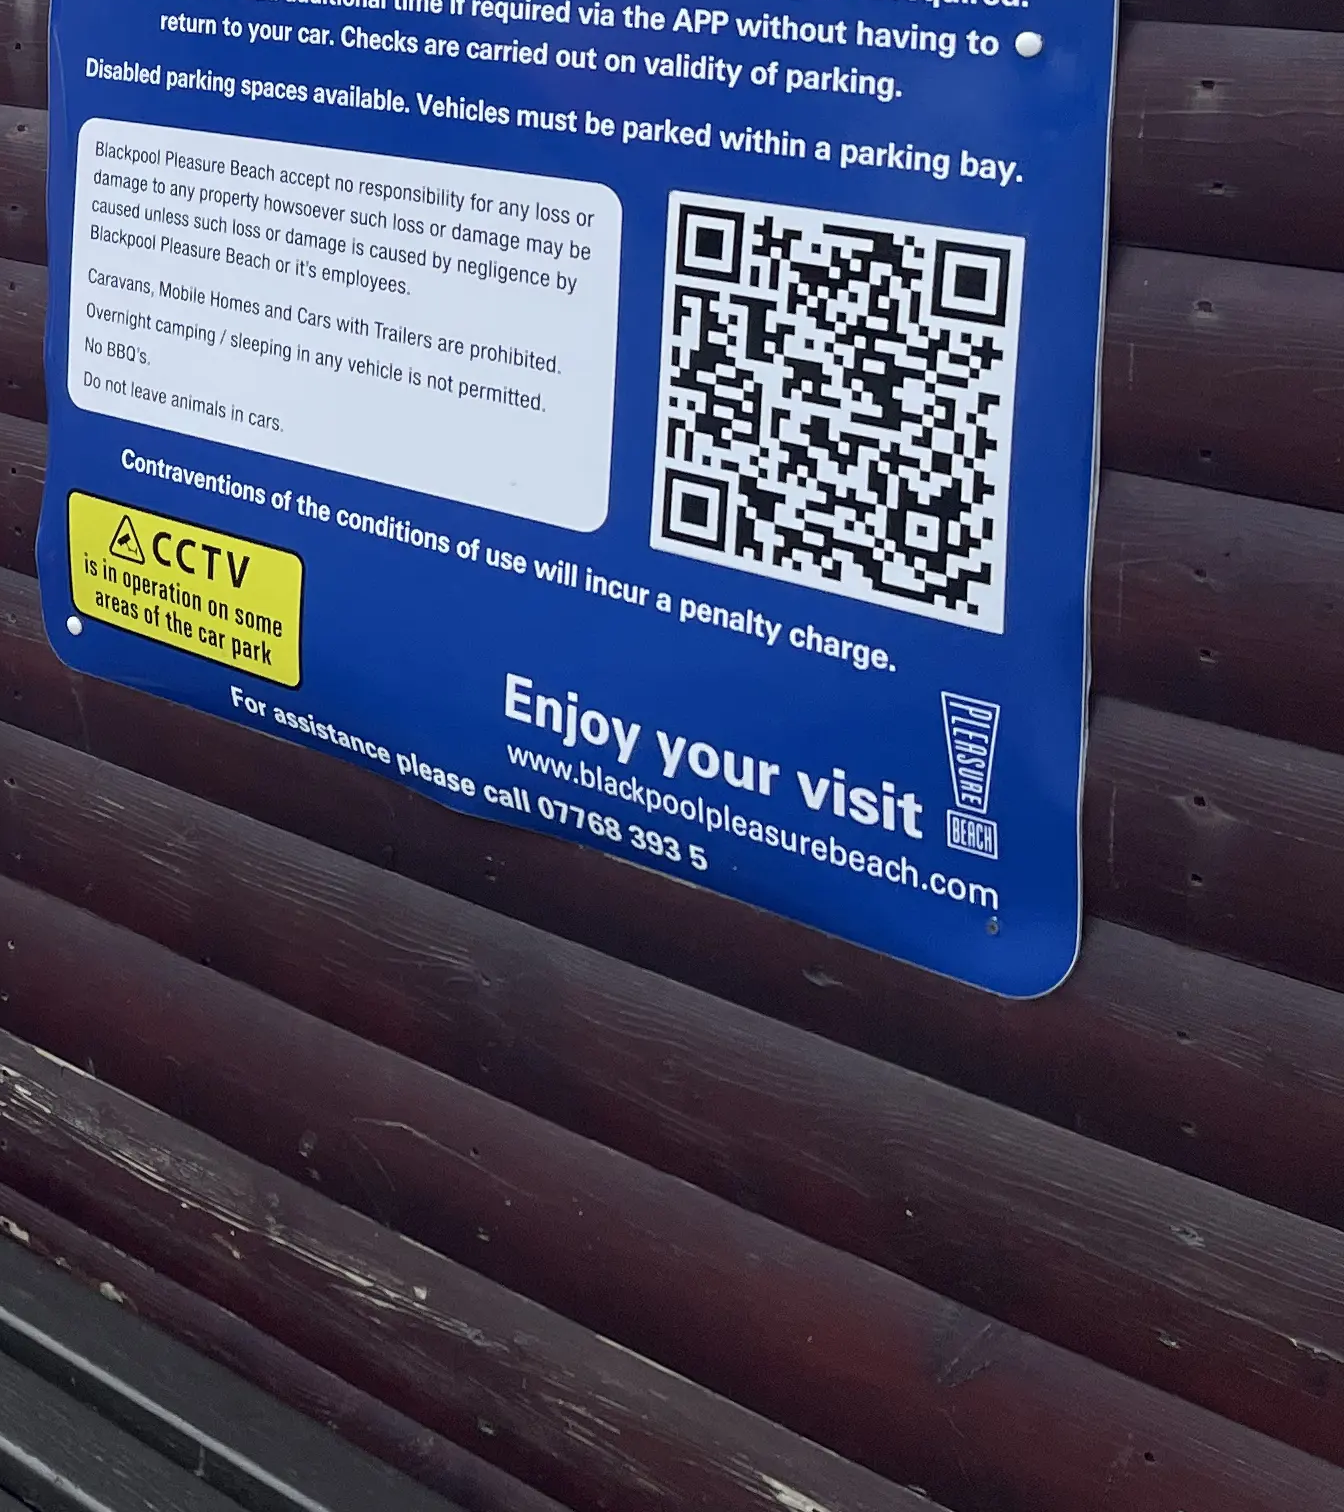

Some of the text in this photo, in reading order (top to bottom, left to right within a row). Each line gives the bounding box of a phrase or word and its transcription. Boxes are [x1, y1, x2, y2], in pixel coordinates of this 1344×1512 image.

[85, 56, 1023, 188] Disabled parking spaces available. Vehicles must be parked within a parking bay.
[95, 140, 596, 228] Blackpool Pleasure Beach accept no responsibility for any loss or
[84, 335, 151, 366] No BBQ's.
[86, 301, 152, 331] Overnight
[155, 318, 216, 347] camping
[230, 331, 292, 363] sleeping
[296, 343, 310, 363] in
[314, 351, 344, 373] any
[347, 357, 403, 382] vehicle
[408, 366, 422, 386] is
[426, 374, 454, 394] not
[458, 380, 546, 413] permitted.
[87, 267, 562, 375] Caravans, Mobile Homes and Cars with Trailers are prohibited.
[83, 370, 284, 433] Do not leave animals in cars.
[84, 552, 282, 637] is in operation on some
[121, 448, 897, 673] Contraventions of the conditions of use will incur a penalty charge.
[152, 531, 250, 588] CCTV
[95, 590, 272, 666] areas of the car park
[230, 684, 708, 871] For assistance please call 07768 393 5
[504, 672, 924, 840] Enjoy your visit
[949, 701, 994, 806] PLEASURE
[506, 743, 999, 911] www.blackpoolpleasurebeach.com
[951, 816, 993, 853] BEACH
